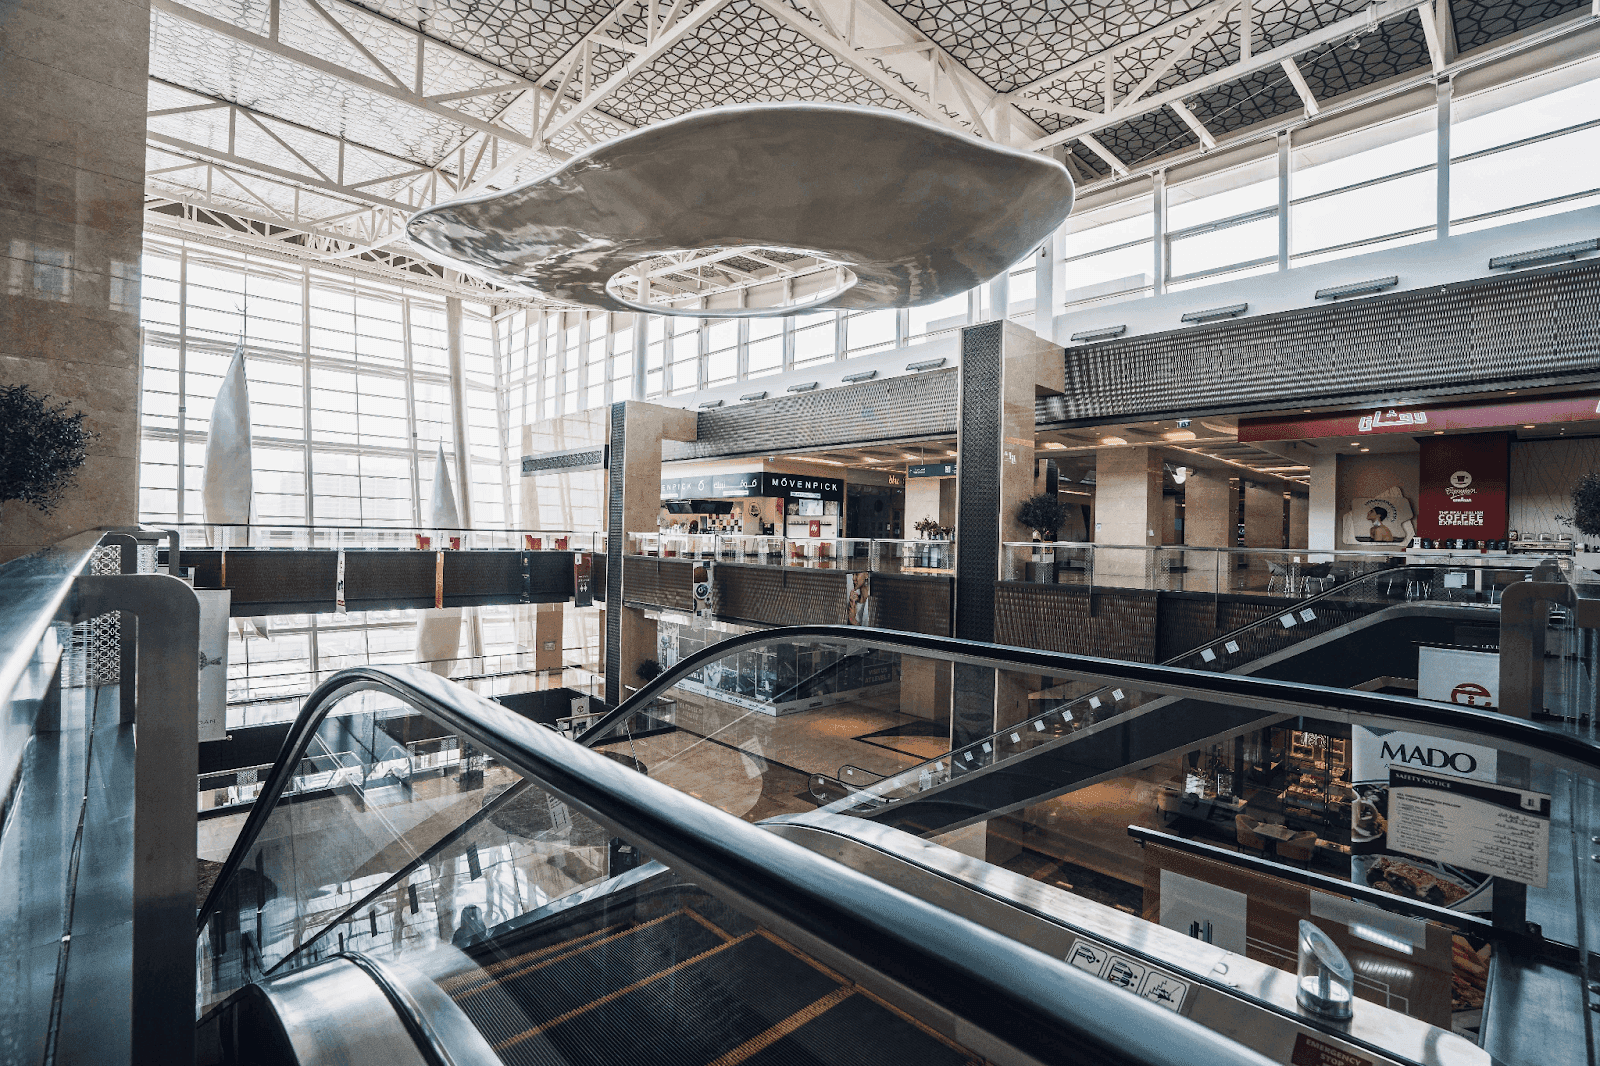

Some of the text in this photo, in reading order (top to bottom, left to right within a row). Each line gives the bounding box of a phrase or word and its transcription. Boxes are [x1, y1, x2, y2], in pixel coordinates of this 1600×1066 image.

[1381, 741, 1477, 773] MADO
[1395, 773, 1451, 788] SAFETY NOTICE
[1306, 1039, 1361, 1066] EMERGENCY
[1320, 1053, 1345, 1066] STOP
